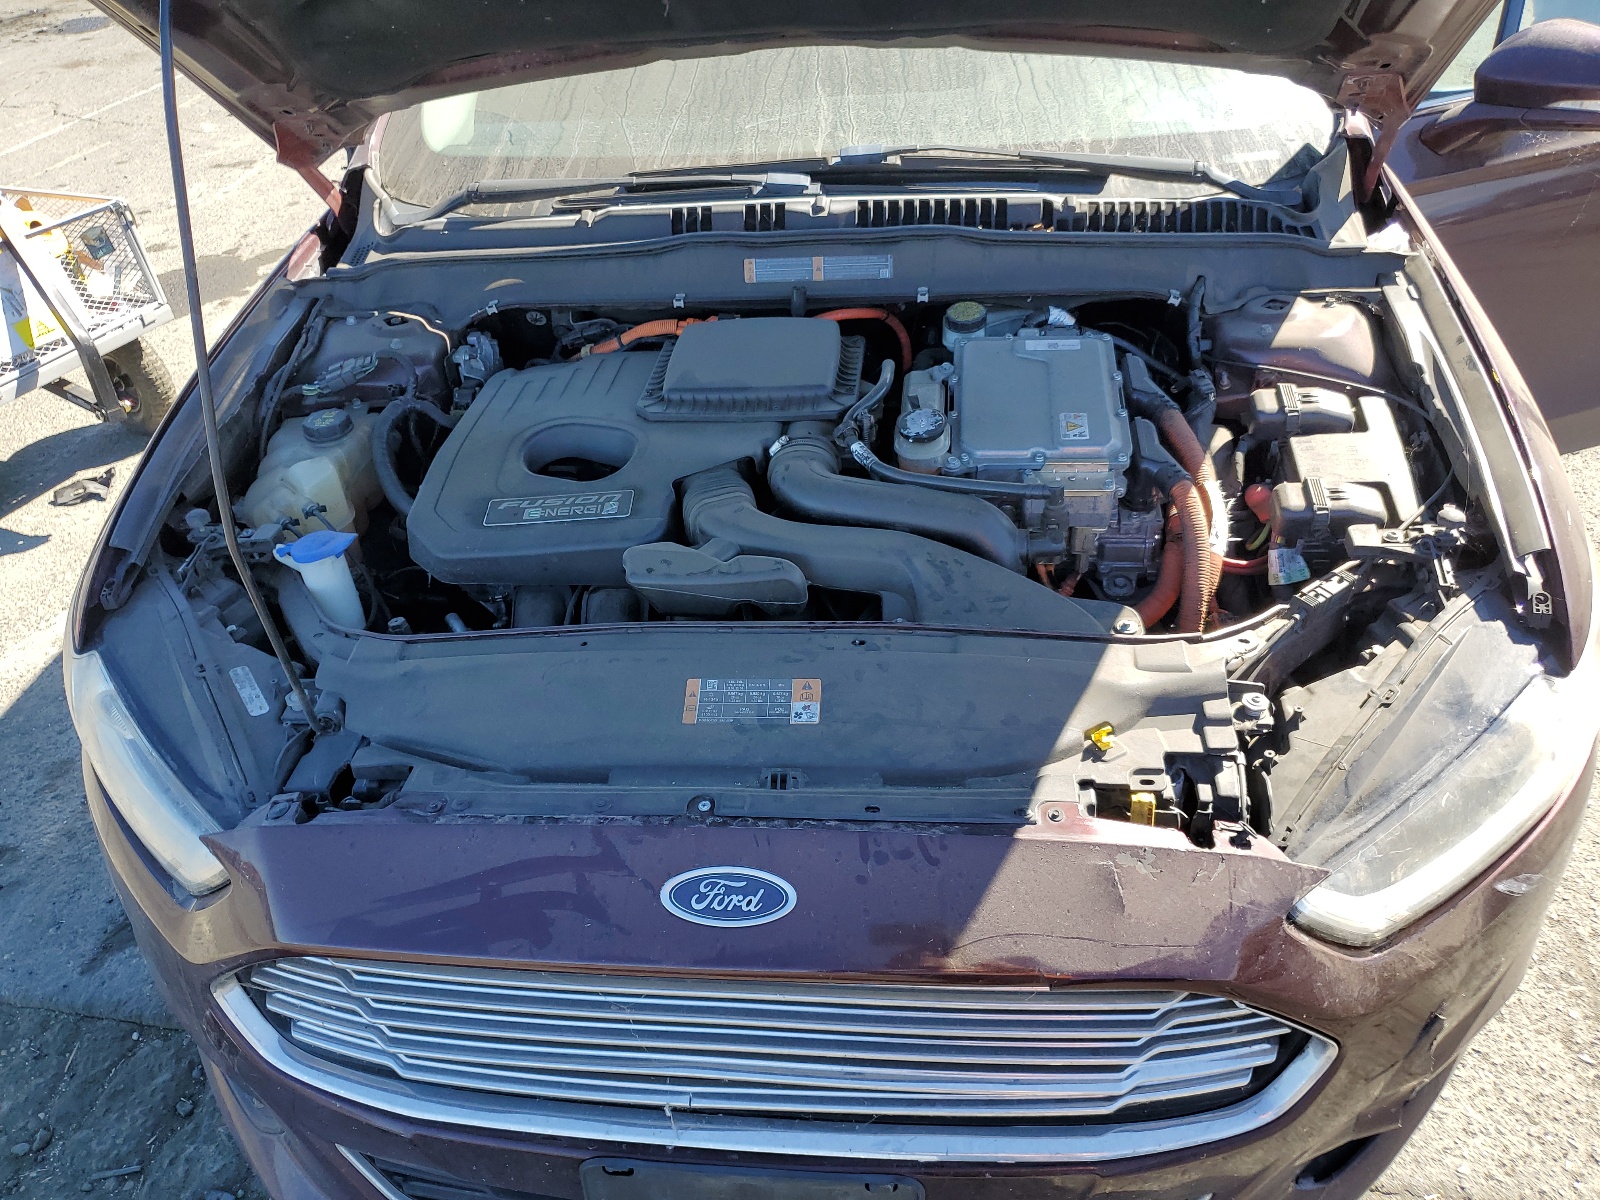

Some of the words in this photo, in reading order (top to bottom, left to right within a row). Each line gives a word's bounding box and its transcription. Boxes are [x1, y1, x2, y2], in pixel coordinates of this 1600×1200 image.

[498, 494, 622, 509] FUSION
[523, 505, 602, 519] ENERGI
[691, 878, 765, 912] Ford
